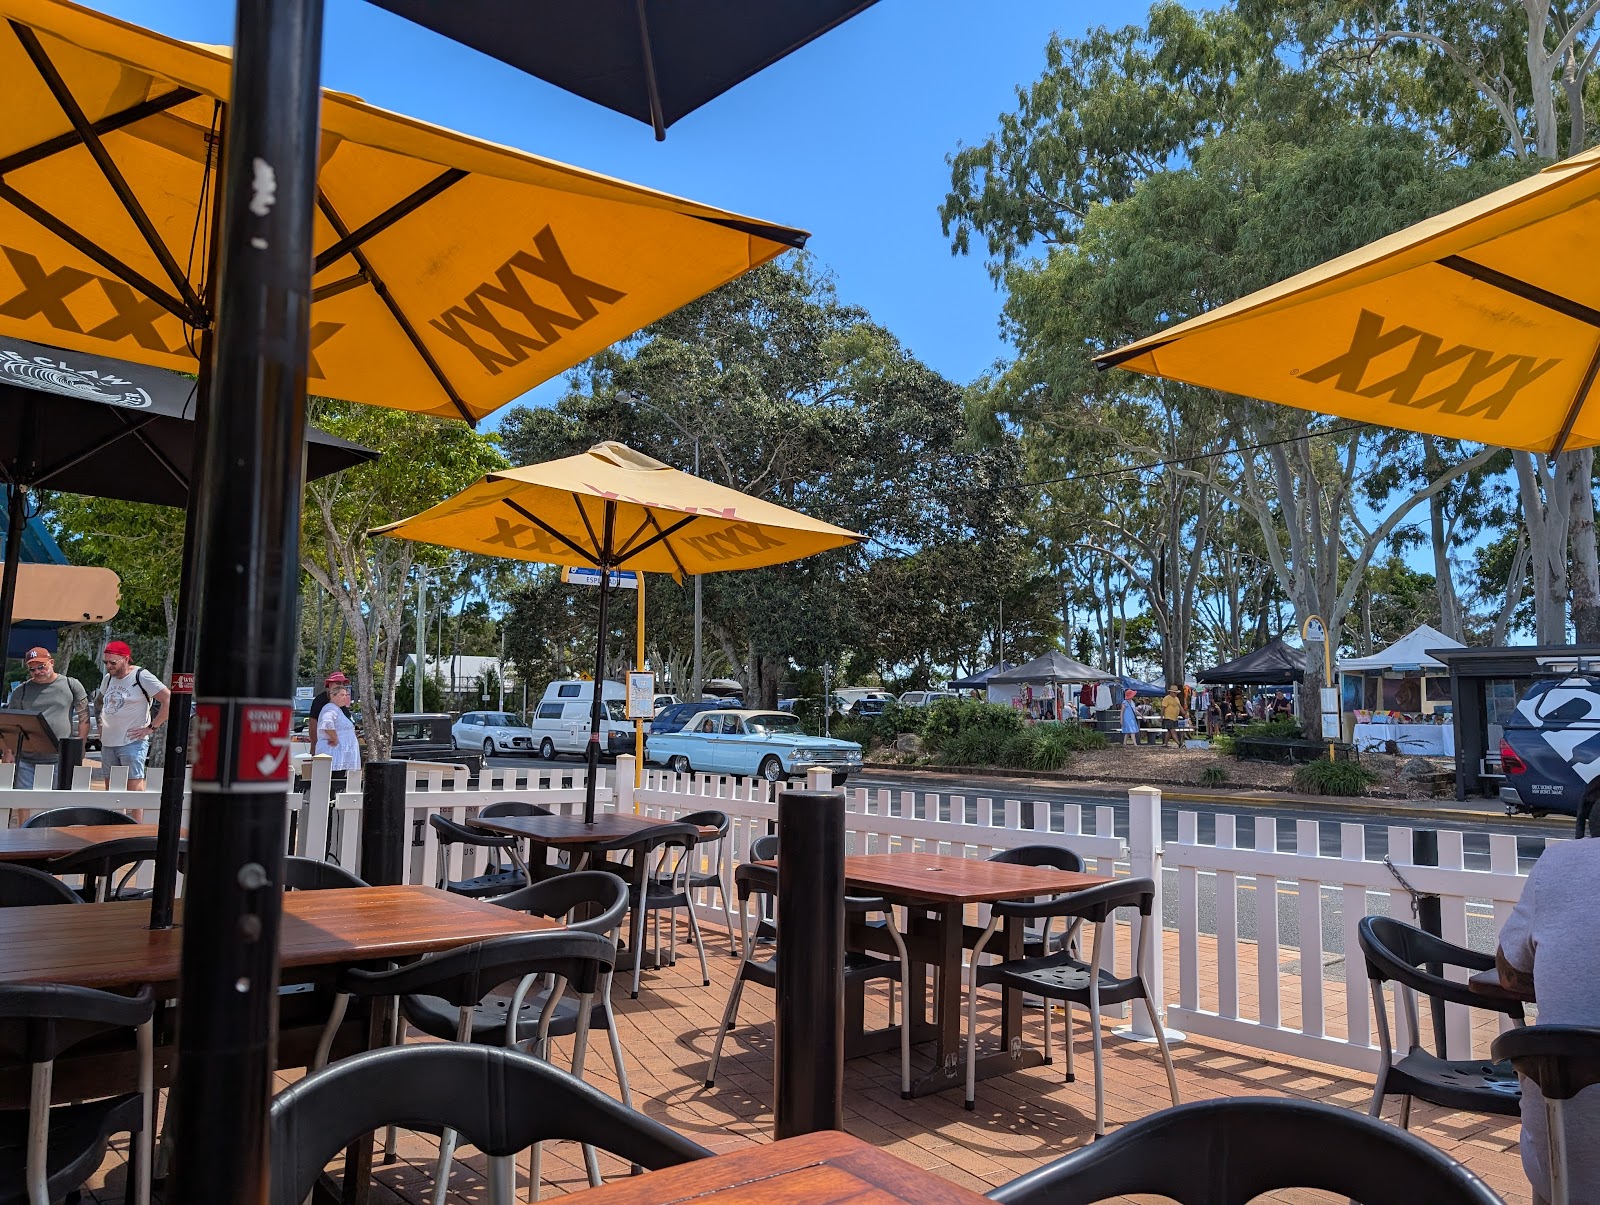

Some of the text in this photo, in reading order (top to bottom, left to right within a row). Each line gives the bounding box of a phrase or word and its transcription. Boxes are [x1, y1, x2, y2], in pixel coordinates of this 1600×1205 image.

[428, 223, 628, 376] XXXX
[33, 356, 133, 385] CLAW
[1296, 308, 1564, 420] XXXX
[679, 522, 787, 561] XXXX
[586, 577, 620, 586] ESPLAD
